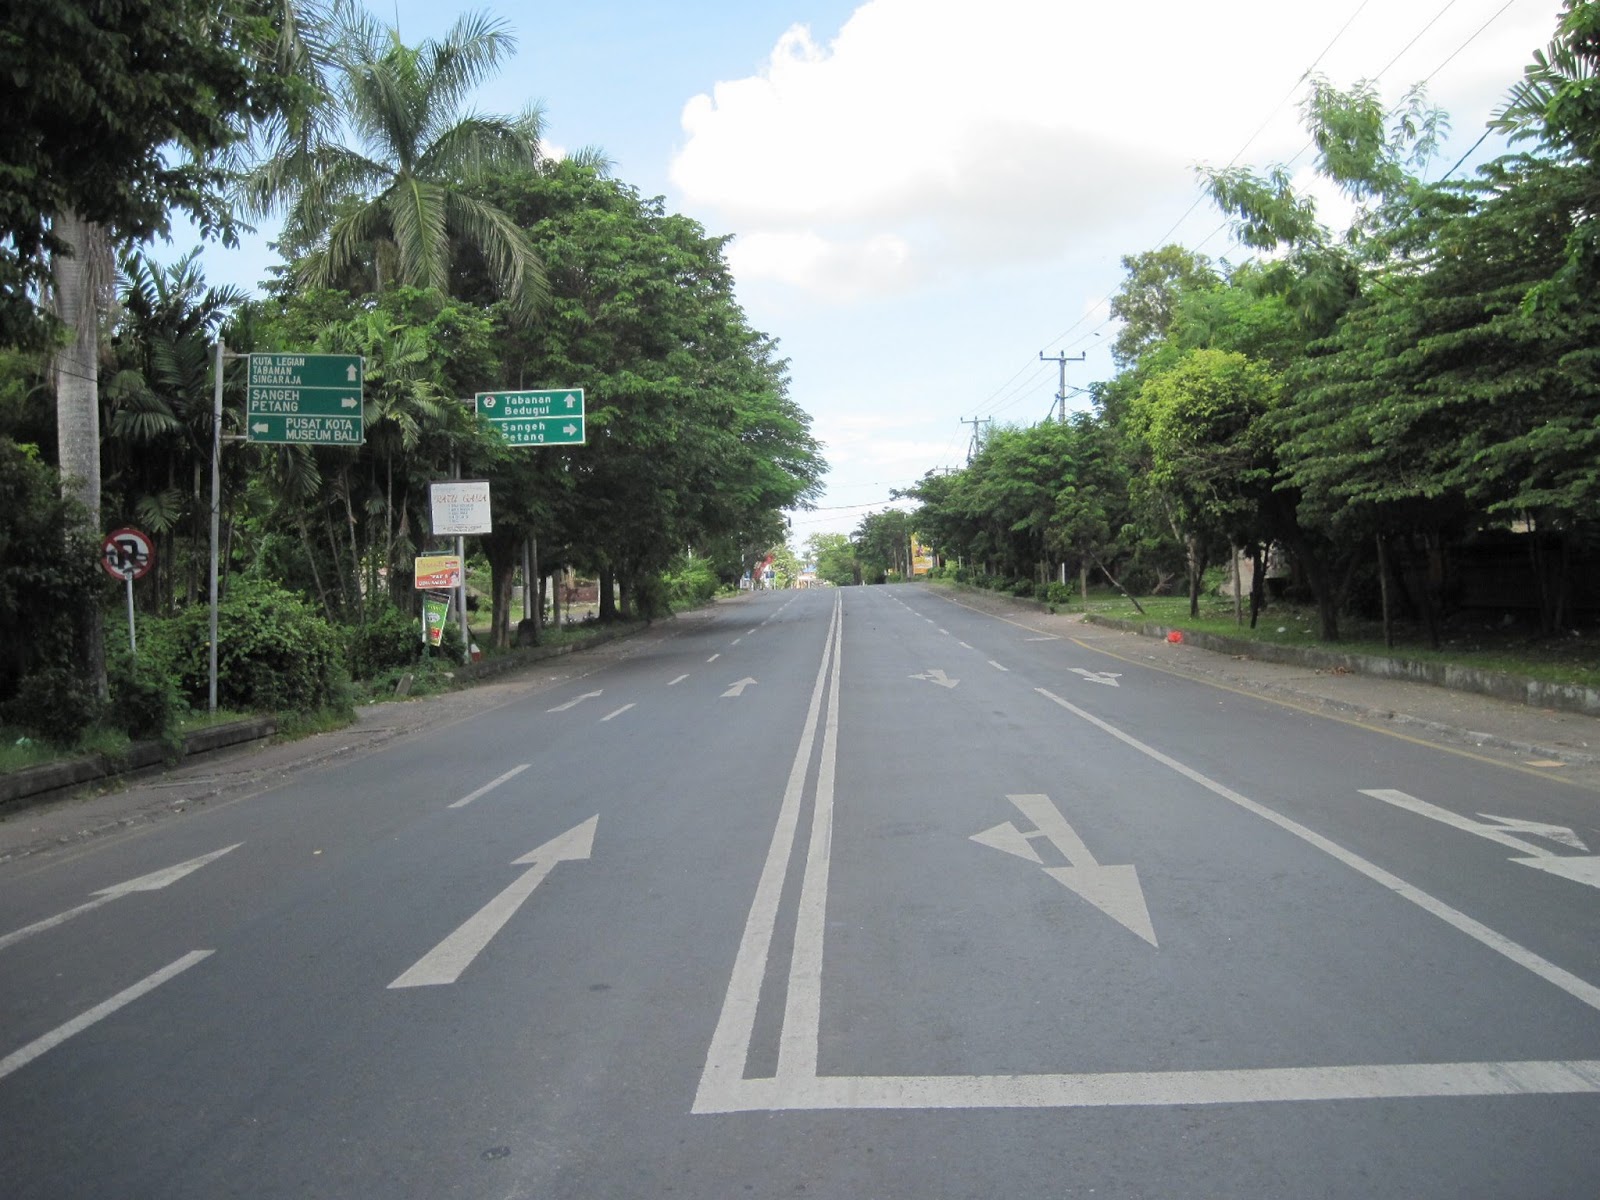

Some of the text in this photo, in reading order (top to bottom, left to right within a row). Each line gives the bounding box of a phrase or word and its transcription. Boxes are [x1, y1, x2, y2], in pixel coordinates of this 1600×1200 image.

[252, 357, 305, 366] KUTA LEGIAN
[253, 366, 292, 375] TABANAN
[252, 375, 302, 385] SINGARAJA
[252, 389, 300, 401] SANGEH
[505, 396, 551, 405] Tabanan
[252, 400, 299, 412] PETANG
[505, 406, 549, 416] Bedugul
[286, 417, 353, 430] PUSAT KOTA
[502, 422, 545, 433] Sangeh
[286, 430, 359, 442] MUSEUM BALI
